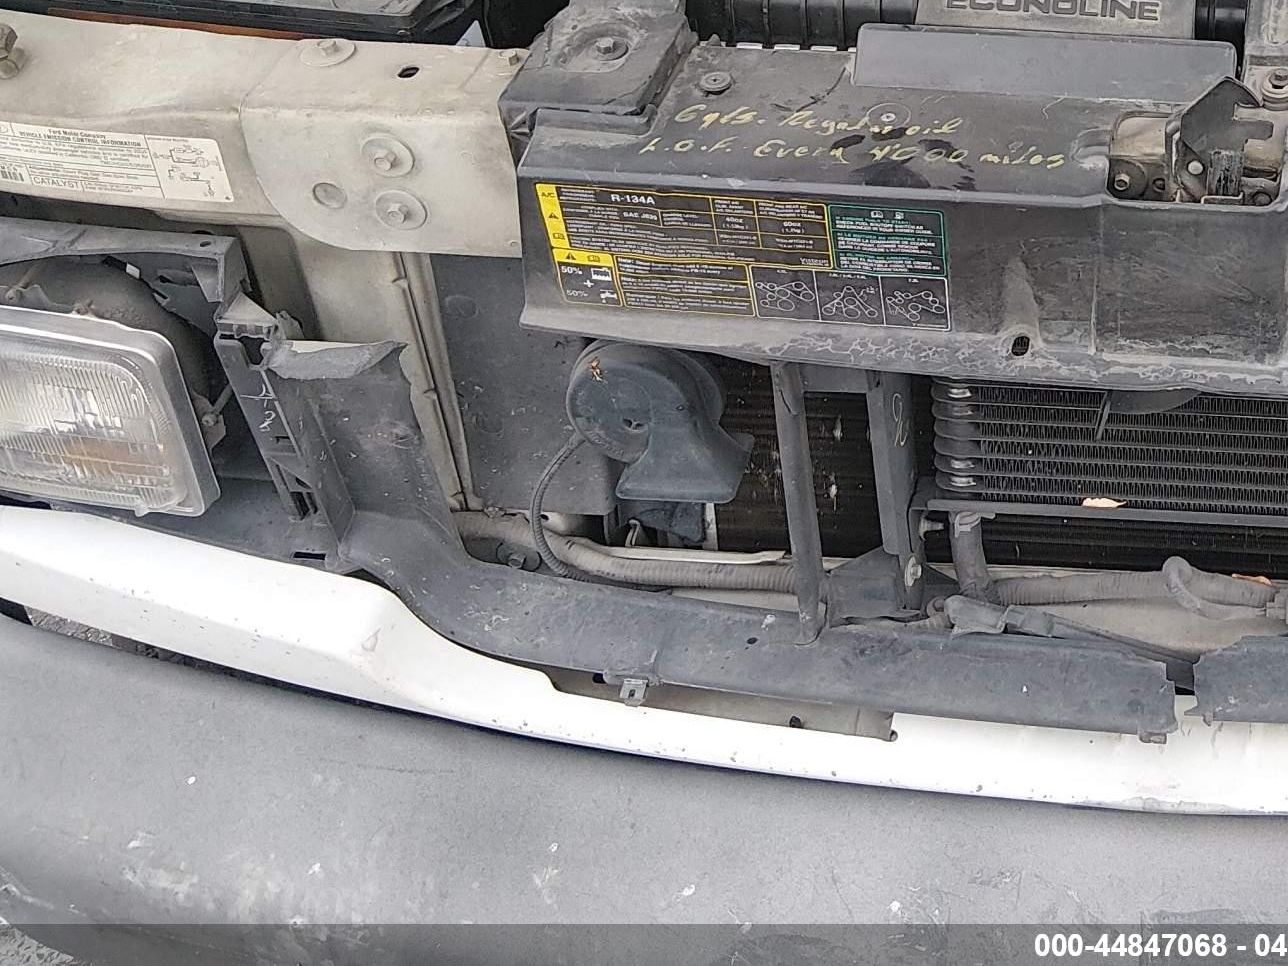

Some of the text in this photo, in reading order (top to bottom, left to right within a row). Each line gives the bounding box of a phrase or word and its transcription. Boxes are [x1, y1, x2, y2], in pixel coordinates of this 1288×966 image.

[33, 176, 79, 188] CATALYST
[610, 194, 655, 205] R-134A
[561, 266, 583, 275] 50%
[567, 289, 588, 297] 50%
